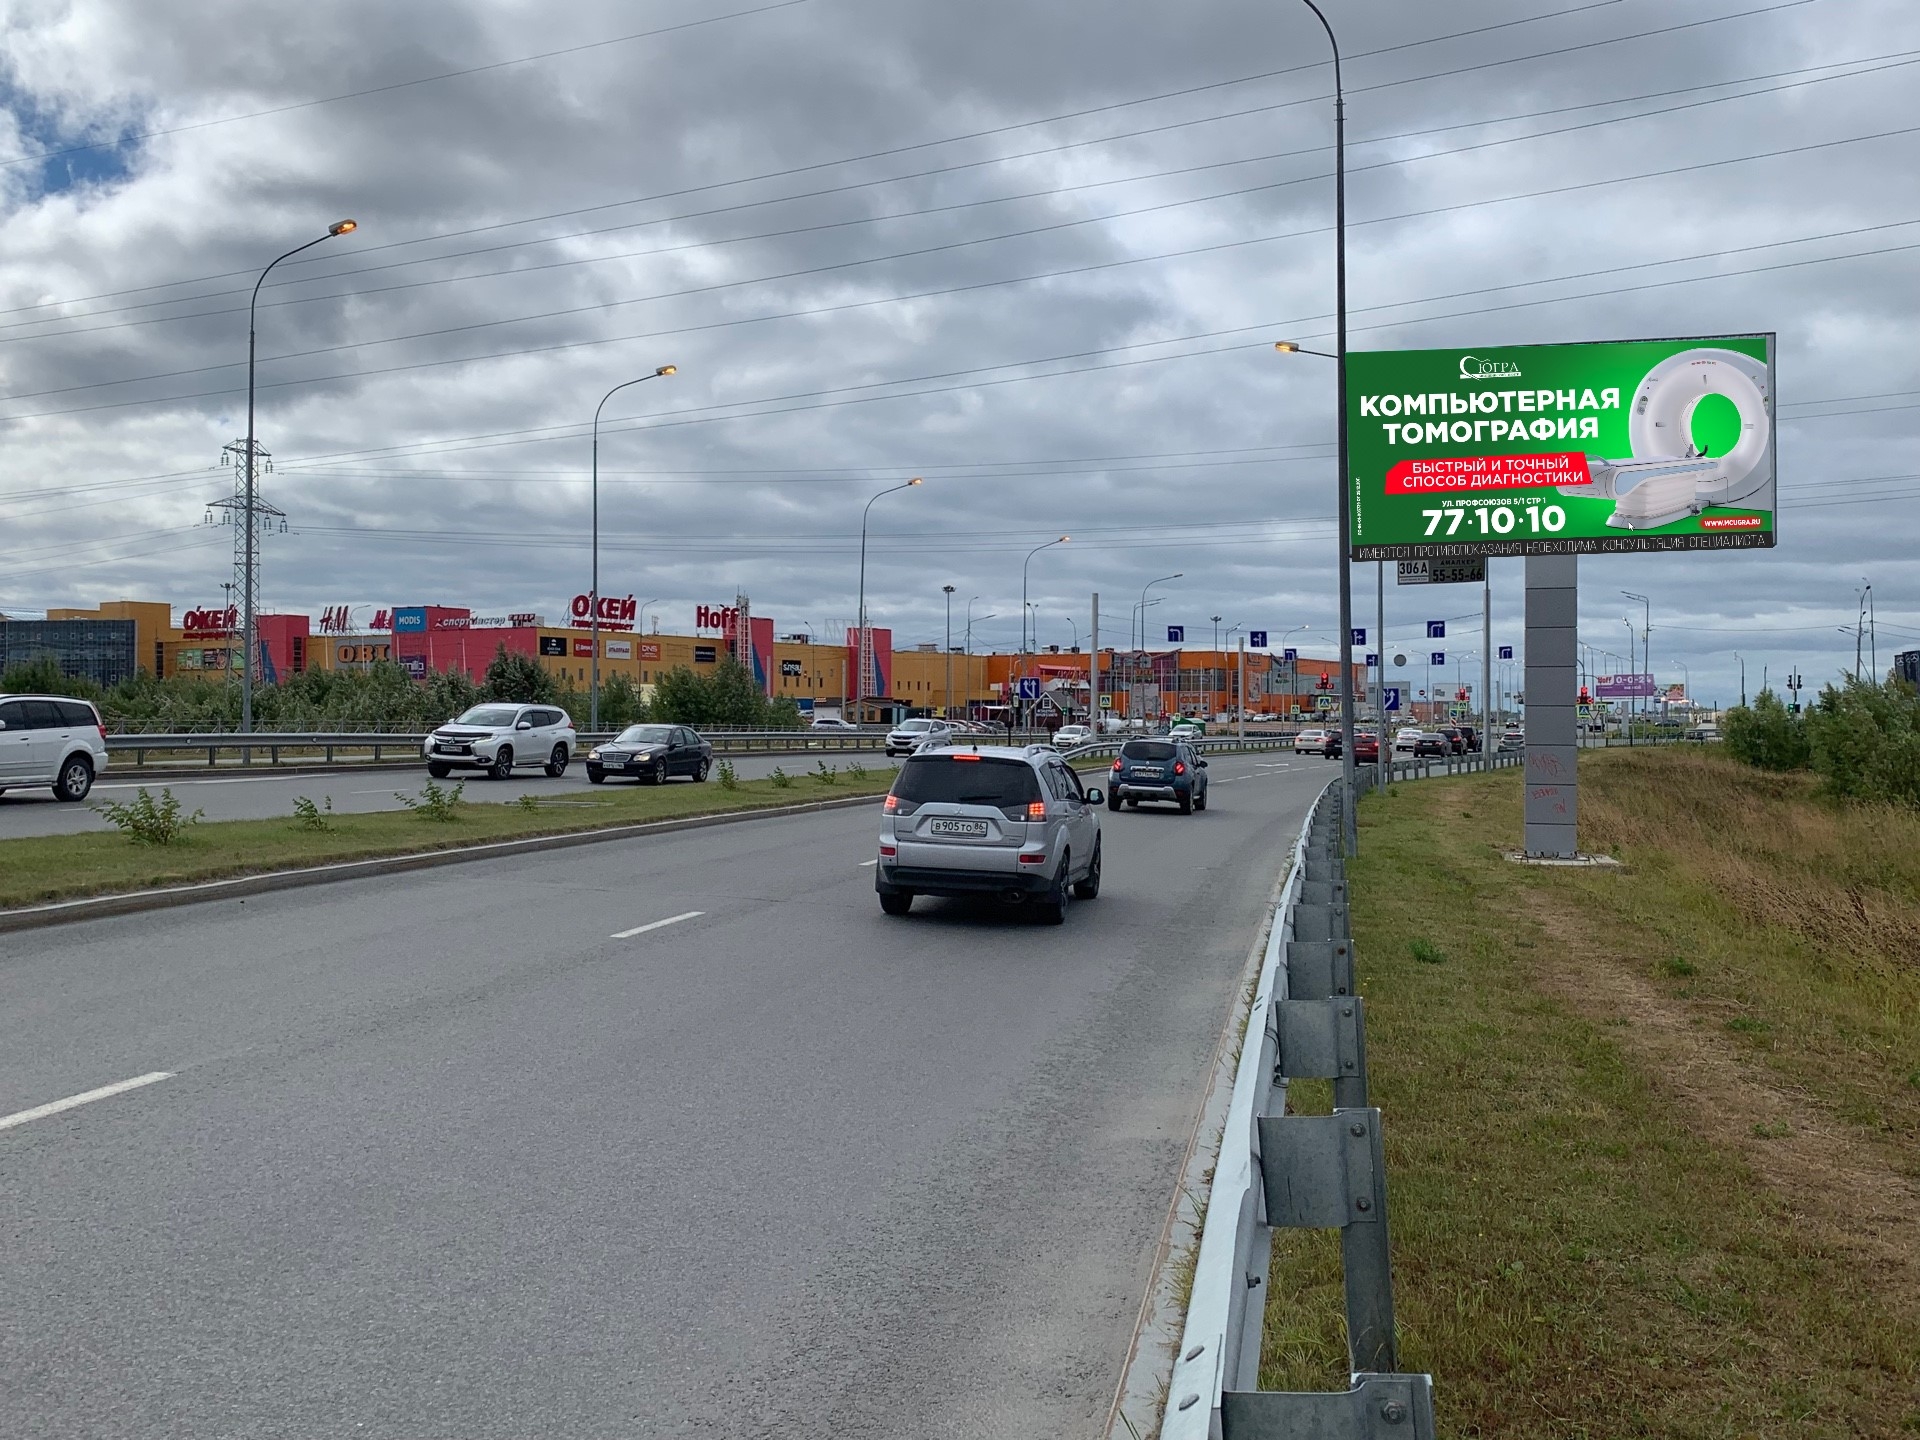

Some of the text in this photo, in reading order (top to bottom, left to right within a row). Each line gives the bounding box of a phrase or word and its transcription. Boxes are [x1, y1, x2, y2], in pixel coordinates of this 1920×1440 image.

[1479, 362, 1519, 373] ЮГРА
[1360, 387, 1620, 417] КОМПЬЮТЕРНАЯ
[1382, 416, 1599, 445] ТОМОГРАФИЯ
[1412, 455, 1569, 474] БЫСТРЫЙ И ТОЧНЫЙ
[1403, 471, 1583, 488] СПОСОБ ДИАГНОСТИКИ
[1442, 500, 1455, 508] УЛ.
[1456, 498, 1512, 507] ПРОФСОЮЗОВ
[1513, 497, 1525, 506] 5/1
[1359, 546, 1410, 559] ИМЕЮТСЯ
[1414, 543, 1522, 557] ПРОТИВОПОКАЗАНИЯ
[1526, 541, 1597, 553] НЕОБХОДИМА
[1689, 534, 1766, 549] СПЕЦИАЛИСТА
[1432, 568, 1483, 581] 55-55-66
[398, 615, 421, 625] MODIS
[696, 605, 740, 629] Hoff
[338, 644, 390, 663] OBI
